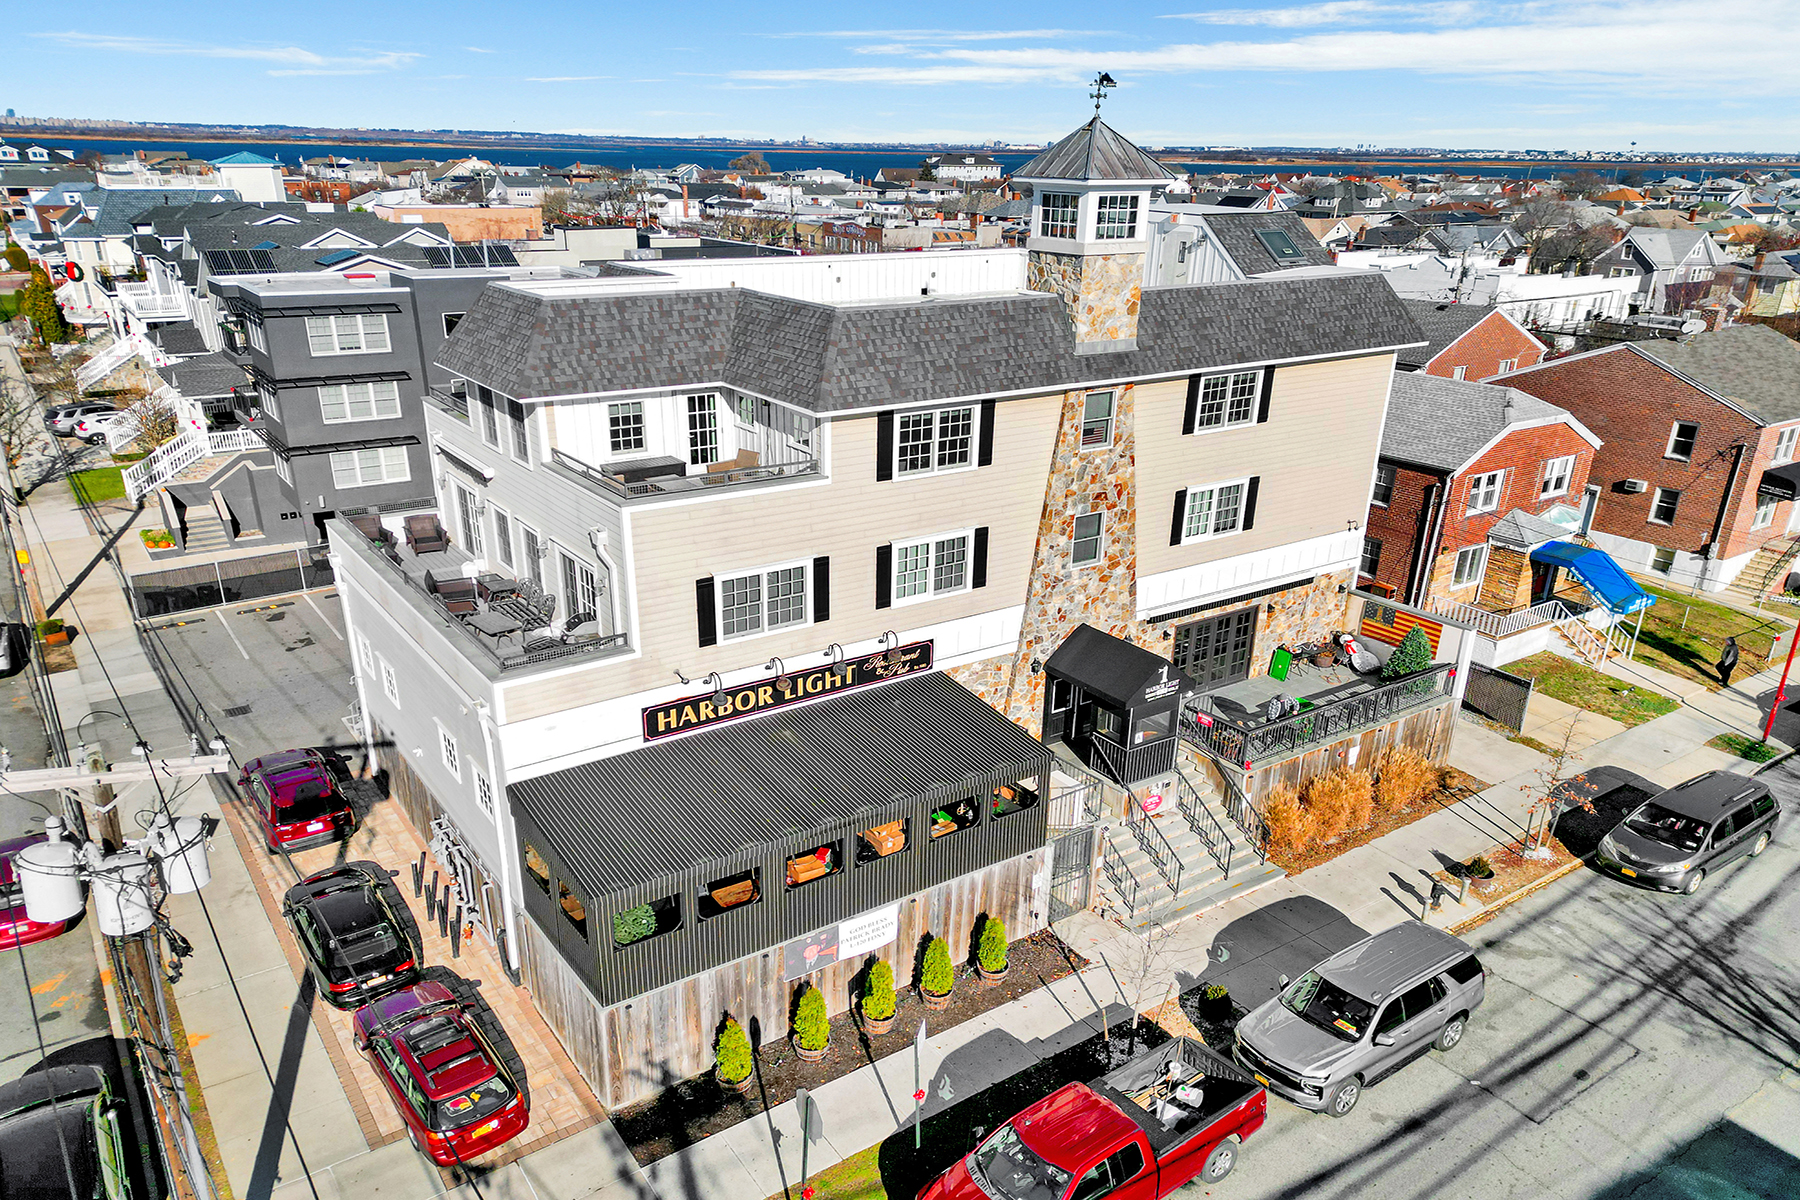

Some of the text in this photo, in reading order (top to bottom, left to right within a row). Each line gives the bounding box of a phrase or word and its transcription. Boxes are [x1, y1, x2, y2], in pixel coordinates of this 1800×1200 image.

[863, 649, 921, 671] Rerant
[883, 662, 911, 678] Pub
[657, 664, 856, 732] HARBOR LIGHT
[840, 921, 895, 945] PATRICK BRADY
[849, 917, 888, 934] GOD BLESS
[867, 931, 887, 942] FDNY
